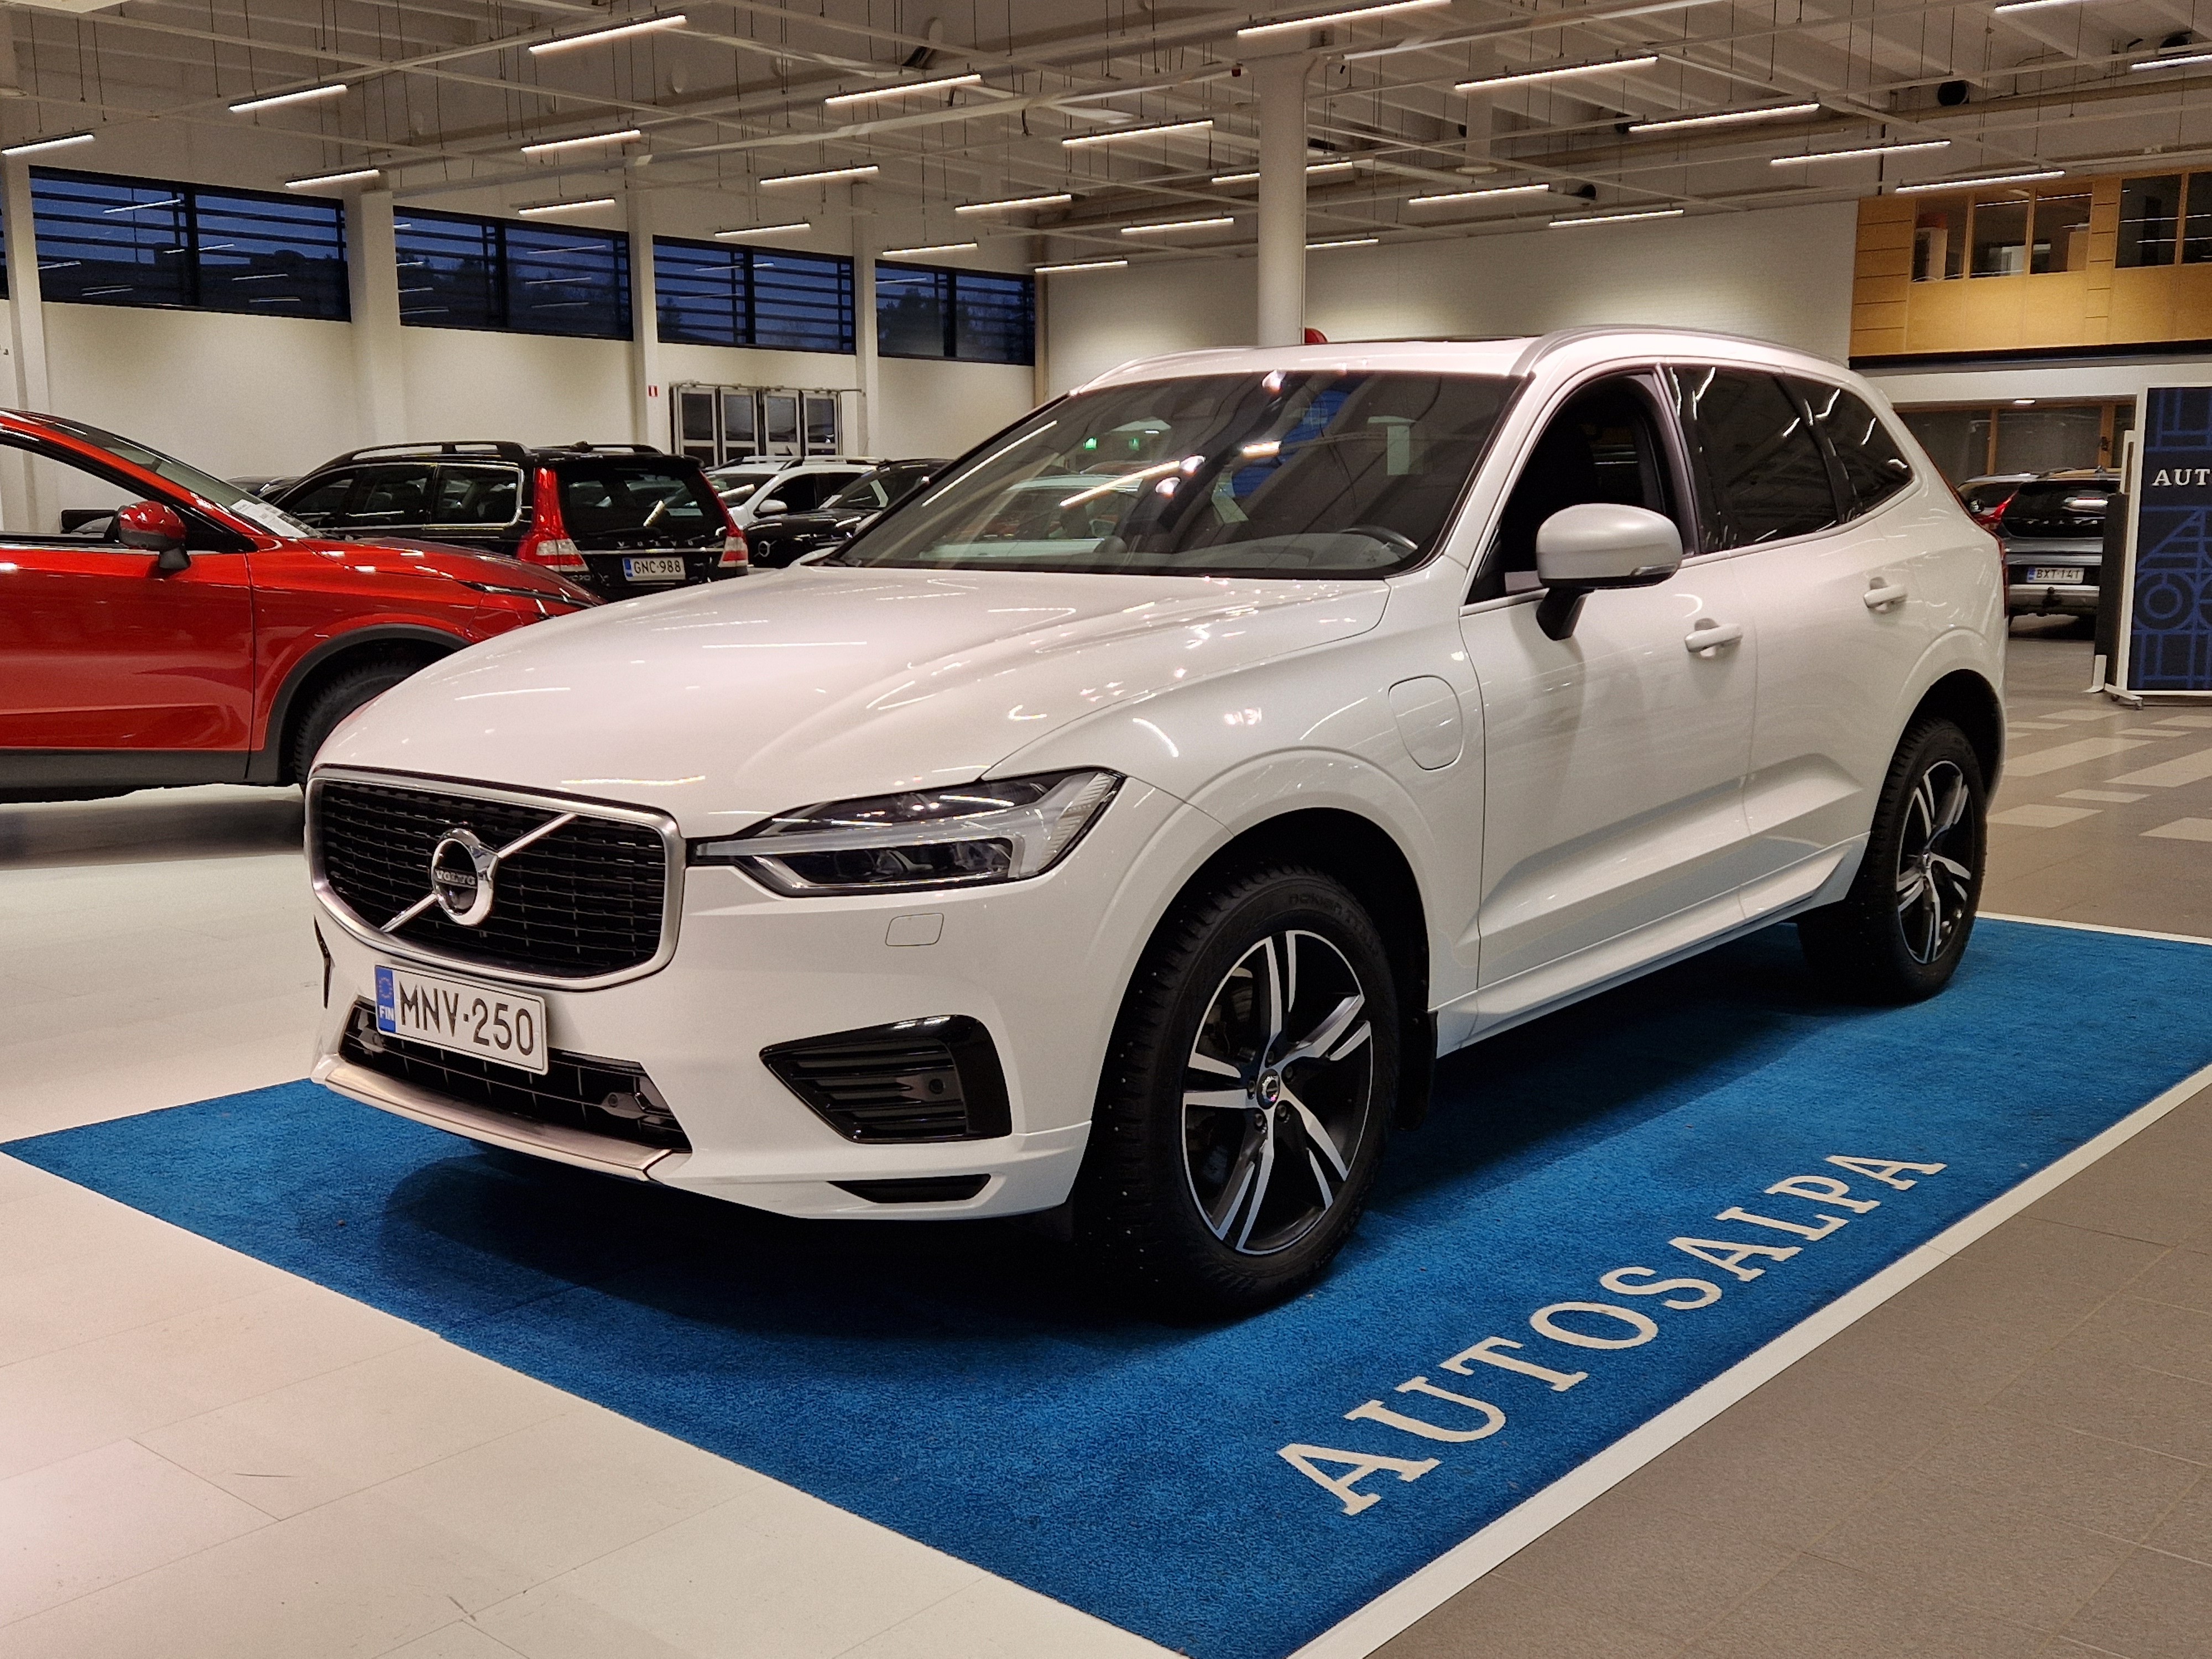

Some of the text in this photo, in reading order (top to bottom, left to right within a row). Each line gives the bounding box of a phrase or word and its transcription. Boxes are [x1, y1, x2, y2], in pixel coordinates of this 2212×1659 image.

[435, 869, 476, 886] VOLVO
[379, 1004, 394, 1021] FIN
[399, 980, 535, 1056] MNV-250
[1277, 1154, 1948, 1516] AUTOSALPA
